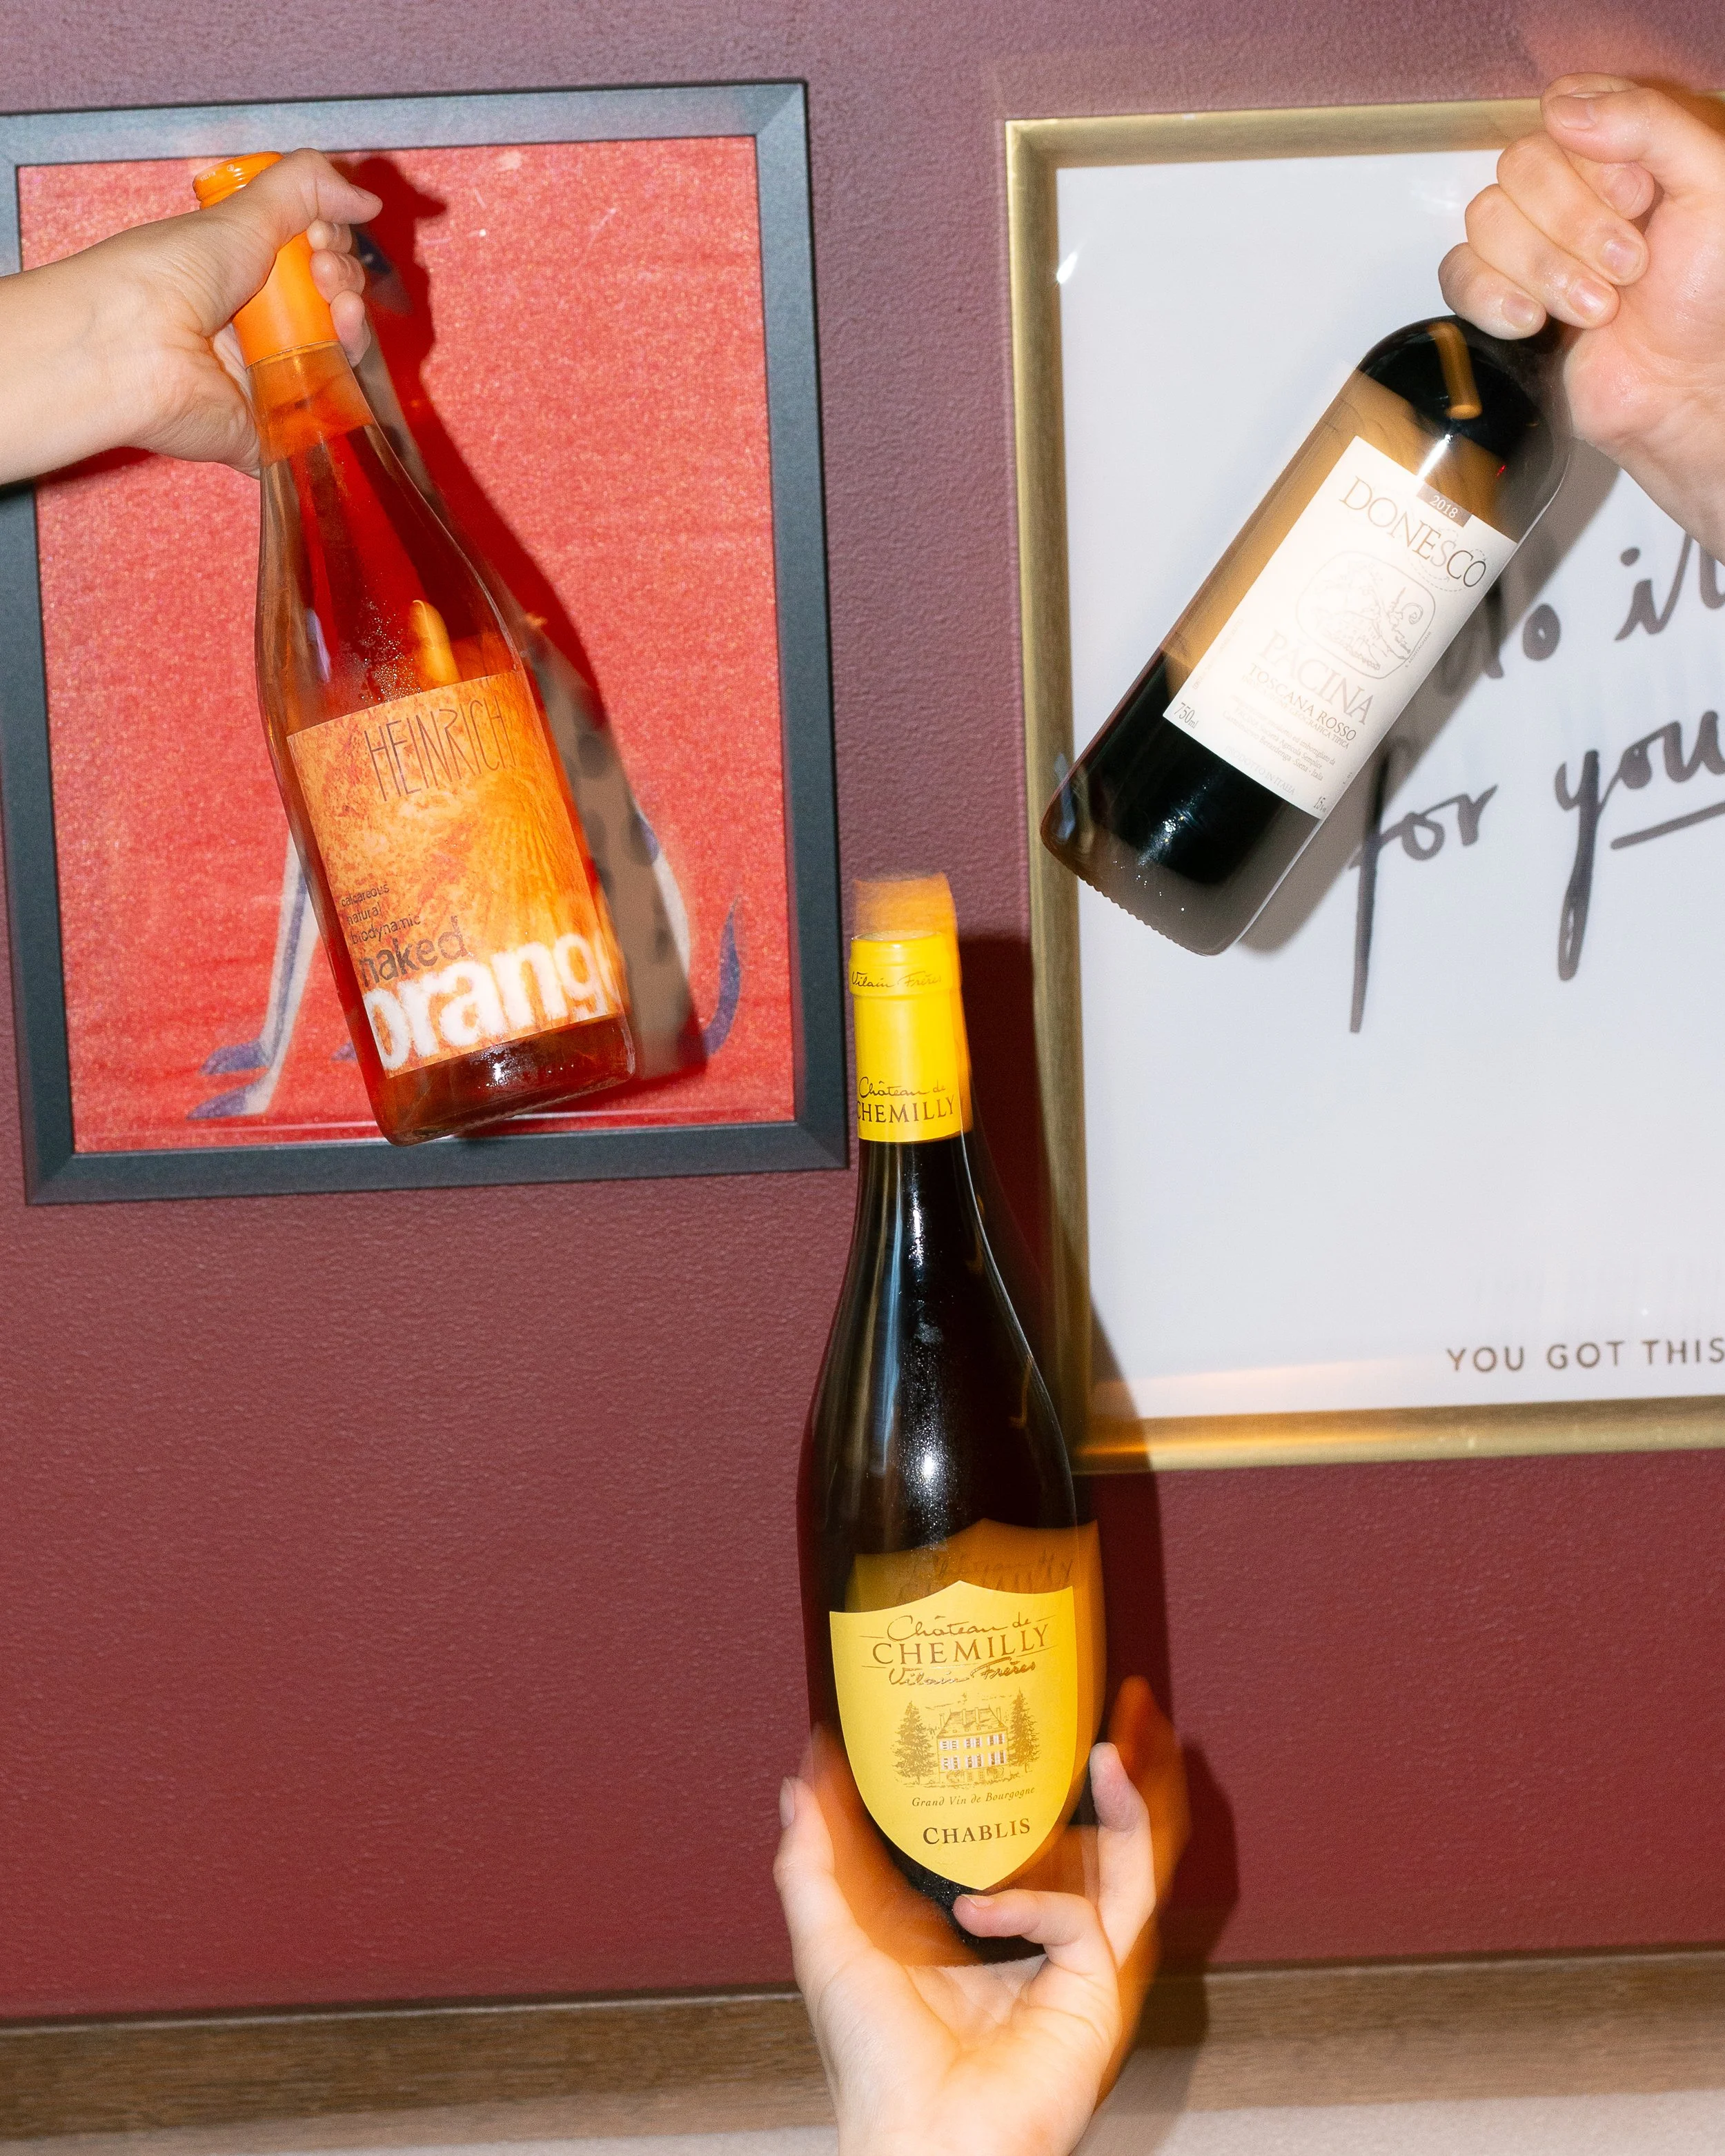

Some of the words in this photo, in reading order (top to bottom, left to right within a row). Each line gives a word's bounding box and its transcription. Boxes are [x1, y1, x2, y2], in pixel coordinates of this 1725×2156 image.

[1430, 495, 1459, 519] 2018
[1339, 475, 1487, 588] DONESCO
[1174, 702, 1199, 729] 750ml
[1248, 662, 1314, 717] TOSCANA
[1317, 710, 1357, 742] ROSSO
[364, 695, 517, 802] HEINRICH
[1332, 732, 1350, 750] TIPICA
[1272, 775, 1297, 796] ITALIA
[1310, 767, 1324, 782] Italia
[341, 883, 390, 907] calcareous
[347, 902, 382, 926] natural
[350, 913, 421, 945] biodynamic
[359, 915, 468, 988] naked
[932, 1078, 947, 1093] de
[1447, 1345, 1525, 1372] YOU
[1546, 1340, 1625, 1369] GOT
[1642, 1336, 1725, 1365] THIS
[887, 1614, 1009, 1642] Château
[1012, 1611, 1032, 1628] de
[872, 1623, 1049, 1665] CHEMILLY
[911, 1796, 945, 1807] Grand
[949, 1794, 967, 1806] Vin
[970, 1793, 982, 1804] de
[985, 1786, 1036, 1802] Bourgogne
[923, 1817, 1031, 1845] CHABLIS
